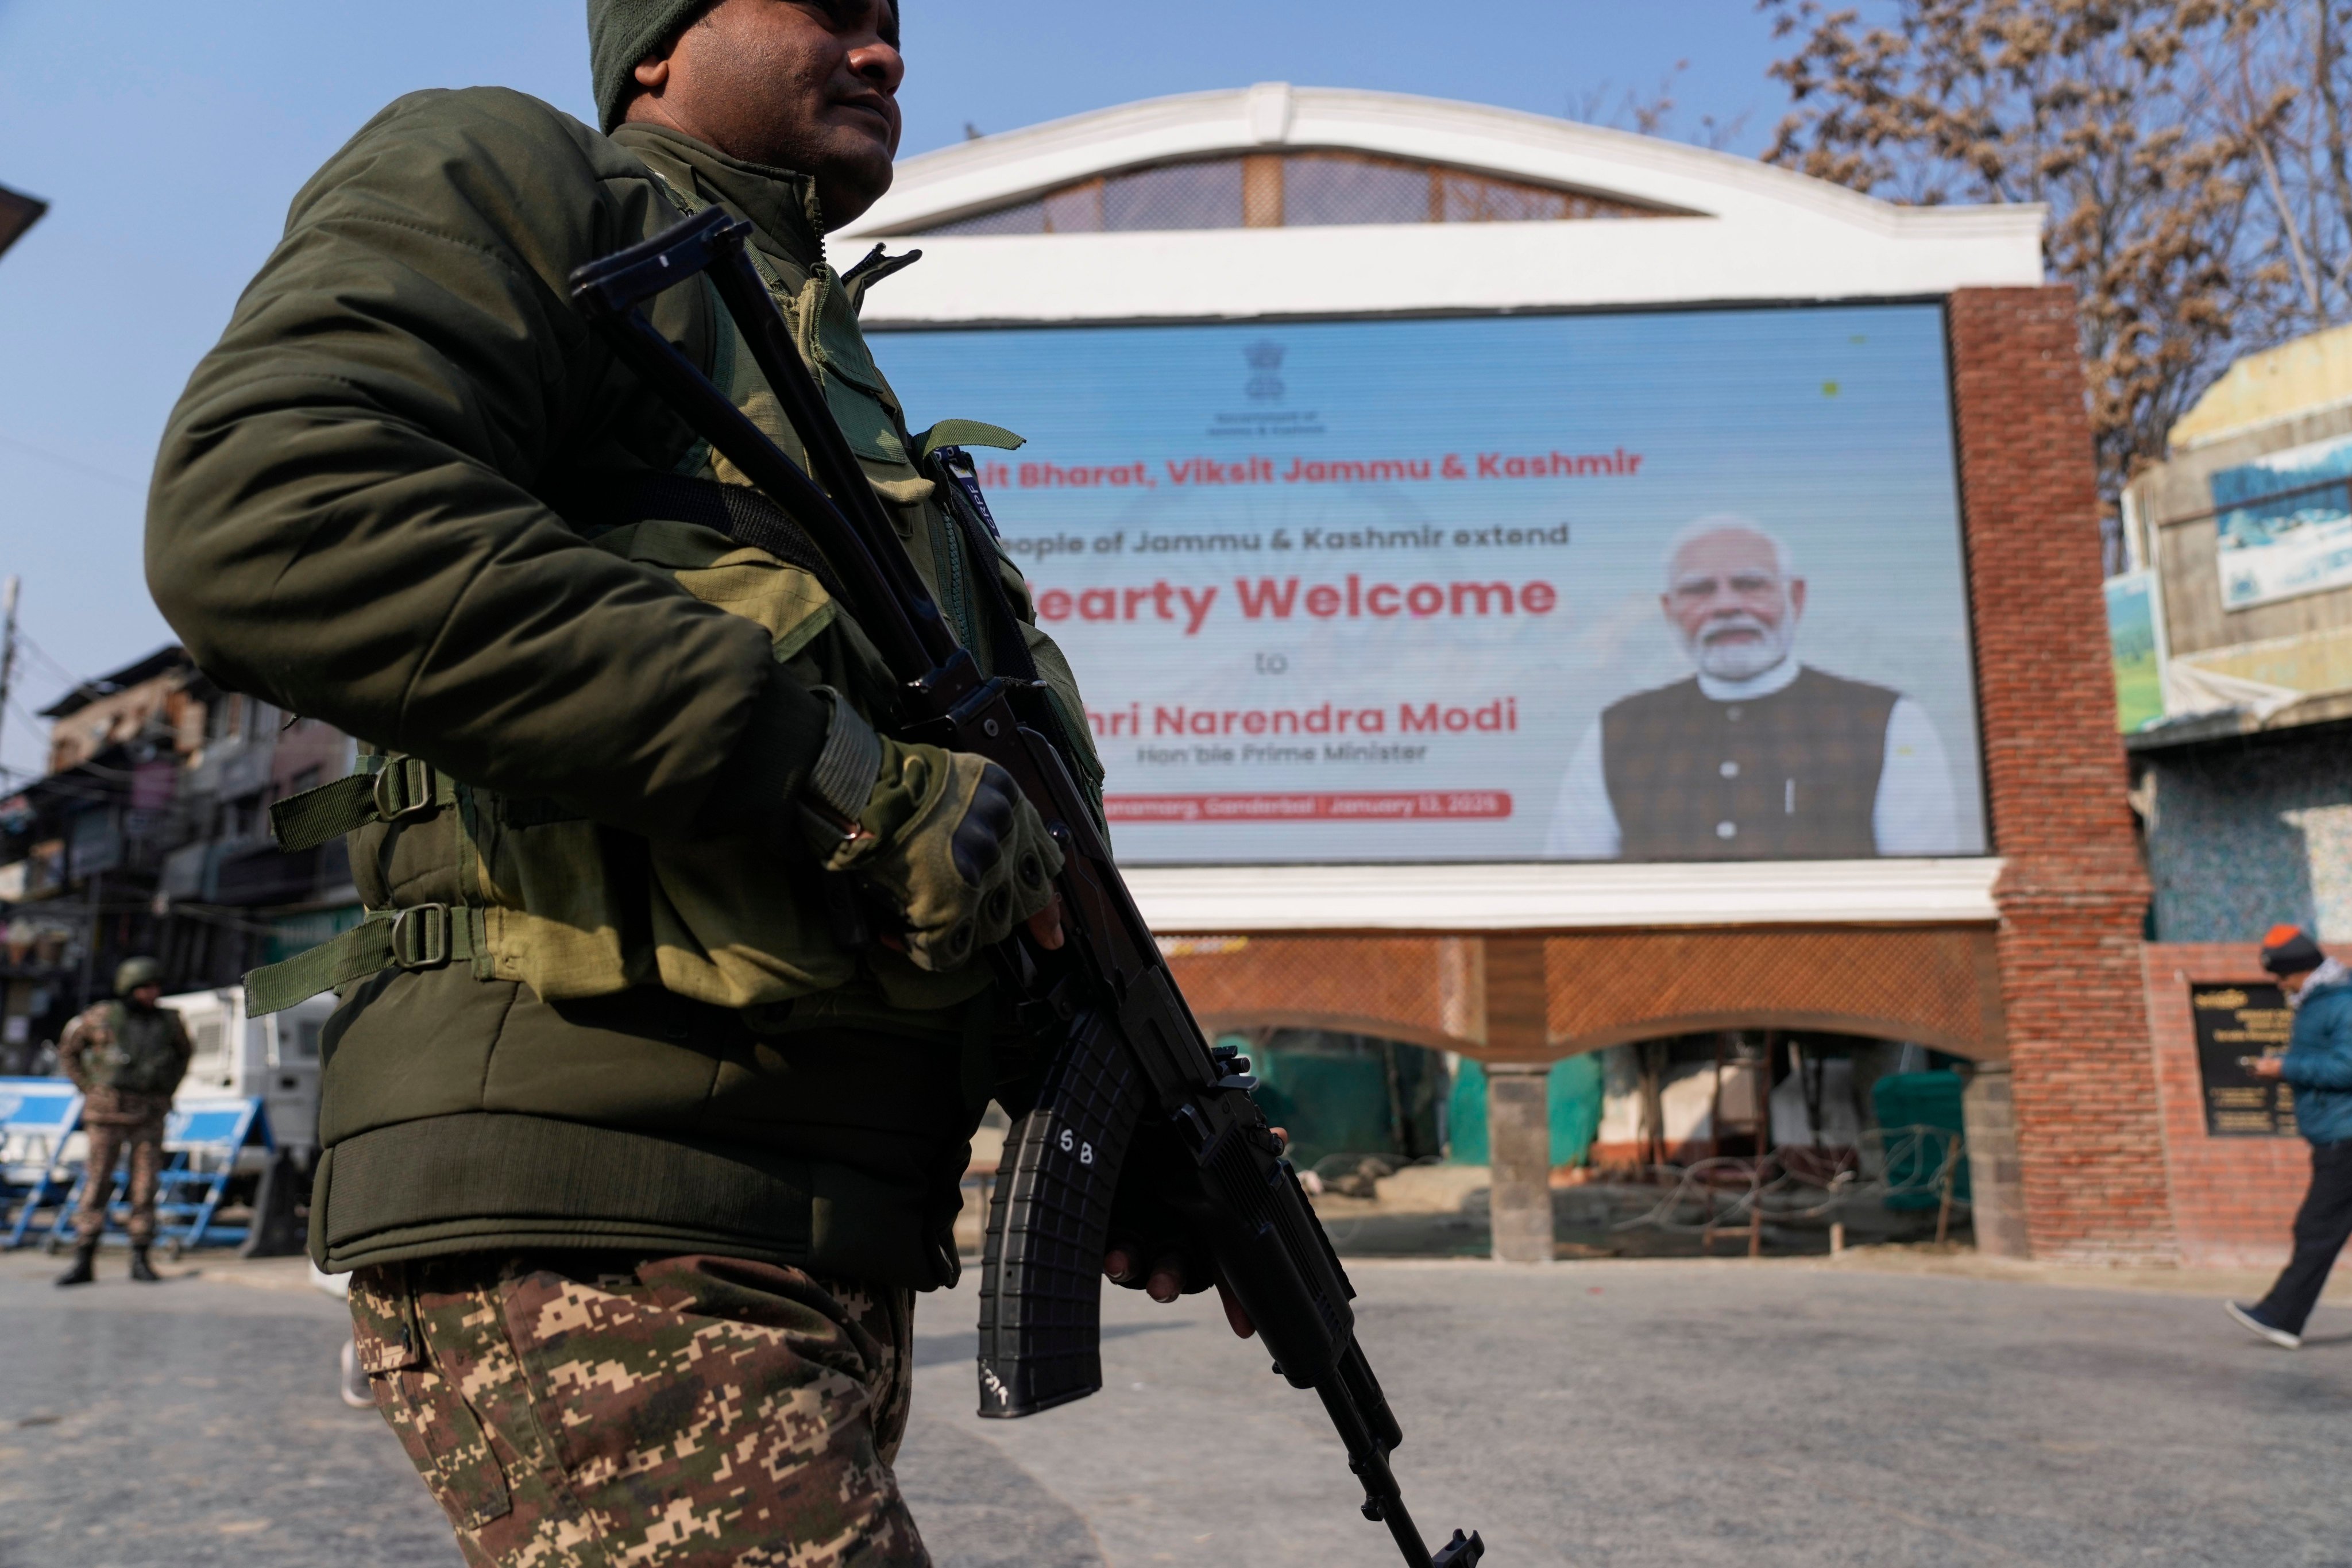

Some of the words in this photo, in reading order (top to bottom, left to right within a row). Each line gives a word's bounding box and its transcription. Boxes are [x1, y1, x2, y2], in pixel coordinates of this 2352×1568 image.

[1018, 459, 1156, 490] Bharat,
[1166, 455, 1275, 485] Viksit
[1283, 457, 1432, 484] Jammu
[1440, 453, 1467, 480] &
[1477, 447, 1644, 478] Kashmir
[967, 484, 995, 530] CRPF
[1094, 531, 1125, 553] of
[1133, 531, 1261, 553] Jammu
[1270, 529, 1292, 551] &
[1303, 525, 1443, 550] Kashmir
[1452, 522, 1569, 547] extend
[1028, 578, 1219, 636] earty
[1234, 573, 1558, 619] Welcome
[1255, 652, 1288, 675] to
[1084, 701, 1140, 736] hri
[1154, 700, 1385, 736] Narendra
[1399, 694, 1518, 733] Modi
[1241, 743, 1316, 761] Prime
[1323, 741, 1428, 761] Minister
